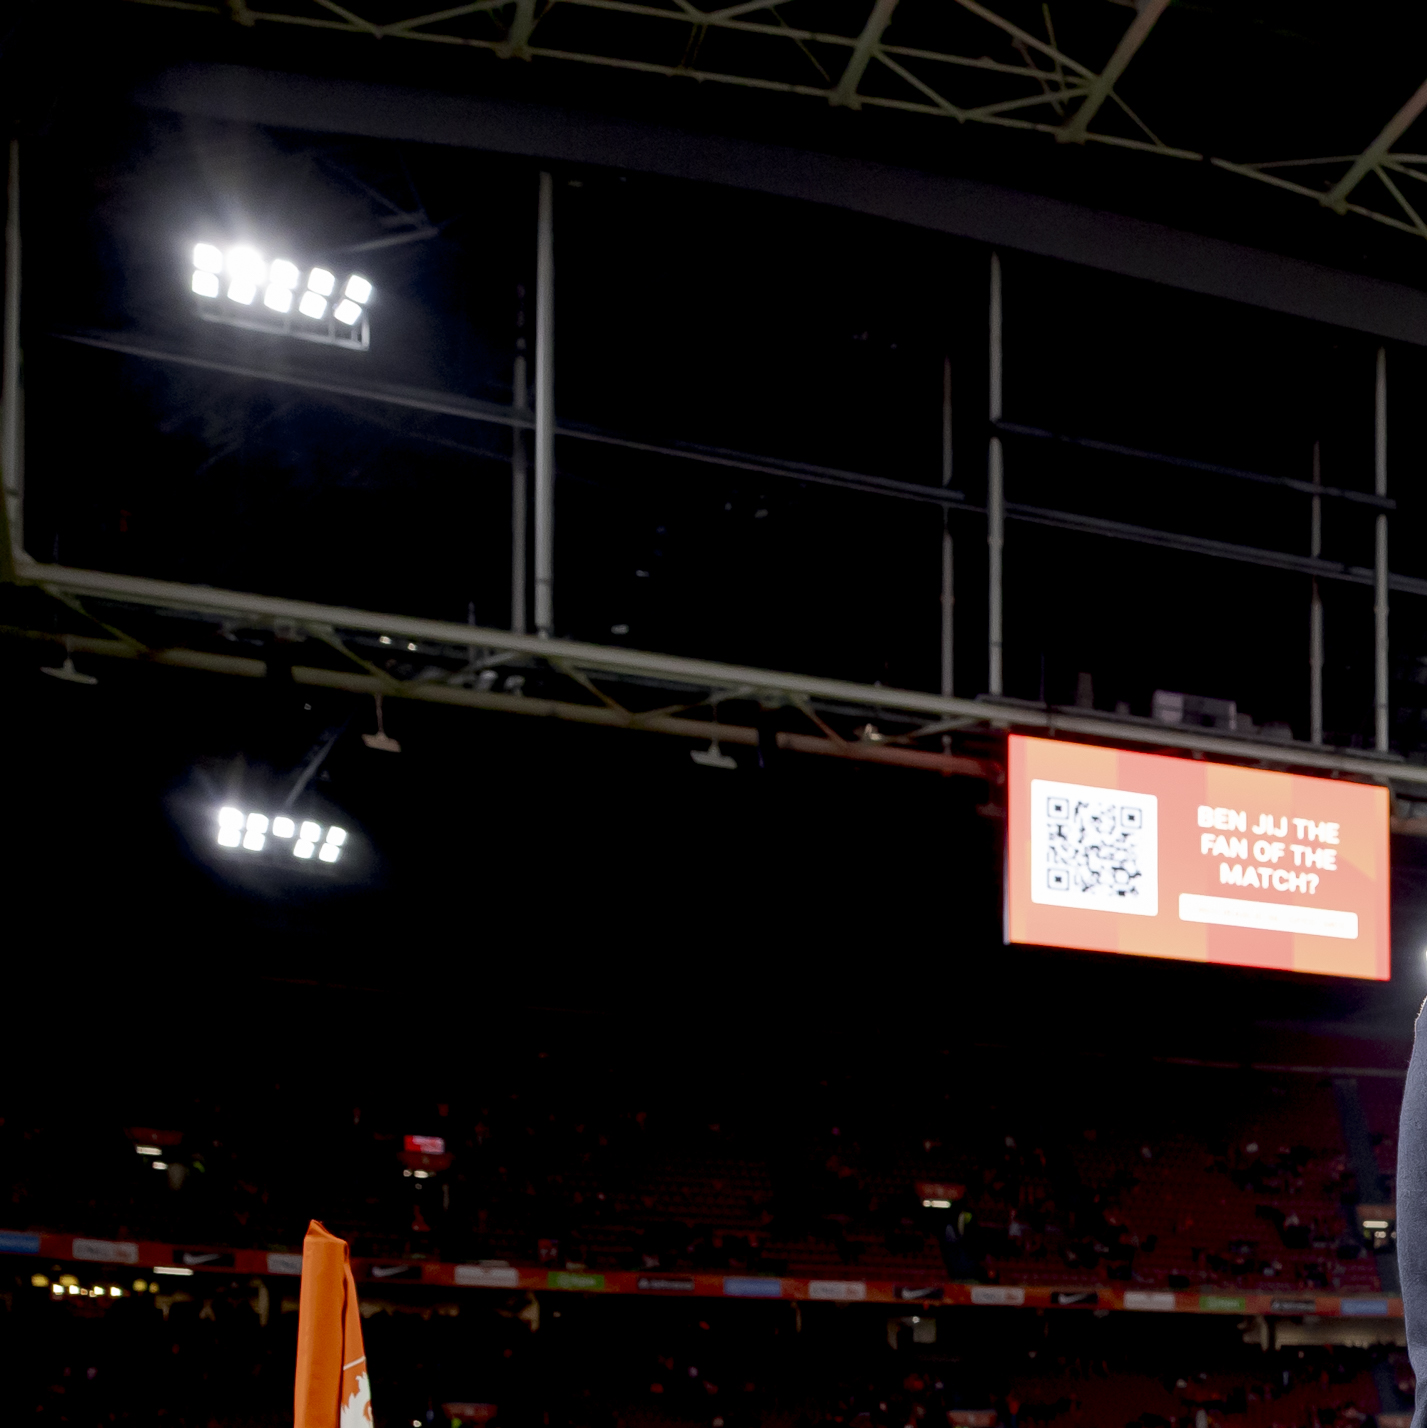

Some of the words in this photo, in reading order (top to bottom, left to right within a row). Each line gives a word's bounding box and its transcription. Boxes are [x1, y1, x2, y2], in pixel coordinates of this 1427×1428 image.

[1197, 805, 1247, 832] BEN
[1252, 813, 1288, 838] JIJ
[1292, 817, 1340, 845] THE
[1200, 832, 1248, 860] FAN
[1253, 839, 1286, 863] OF
[1290, 844, 1338, 871] THE
[1219, 862, 1320, 895] MATCH?
